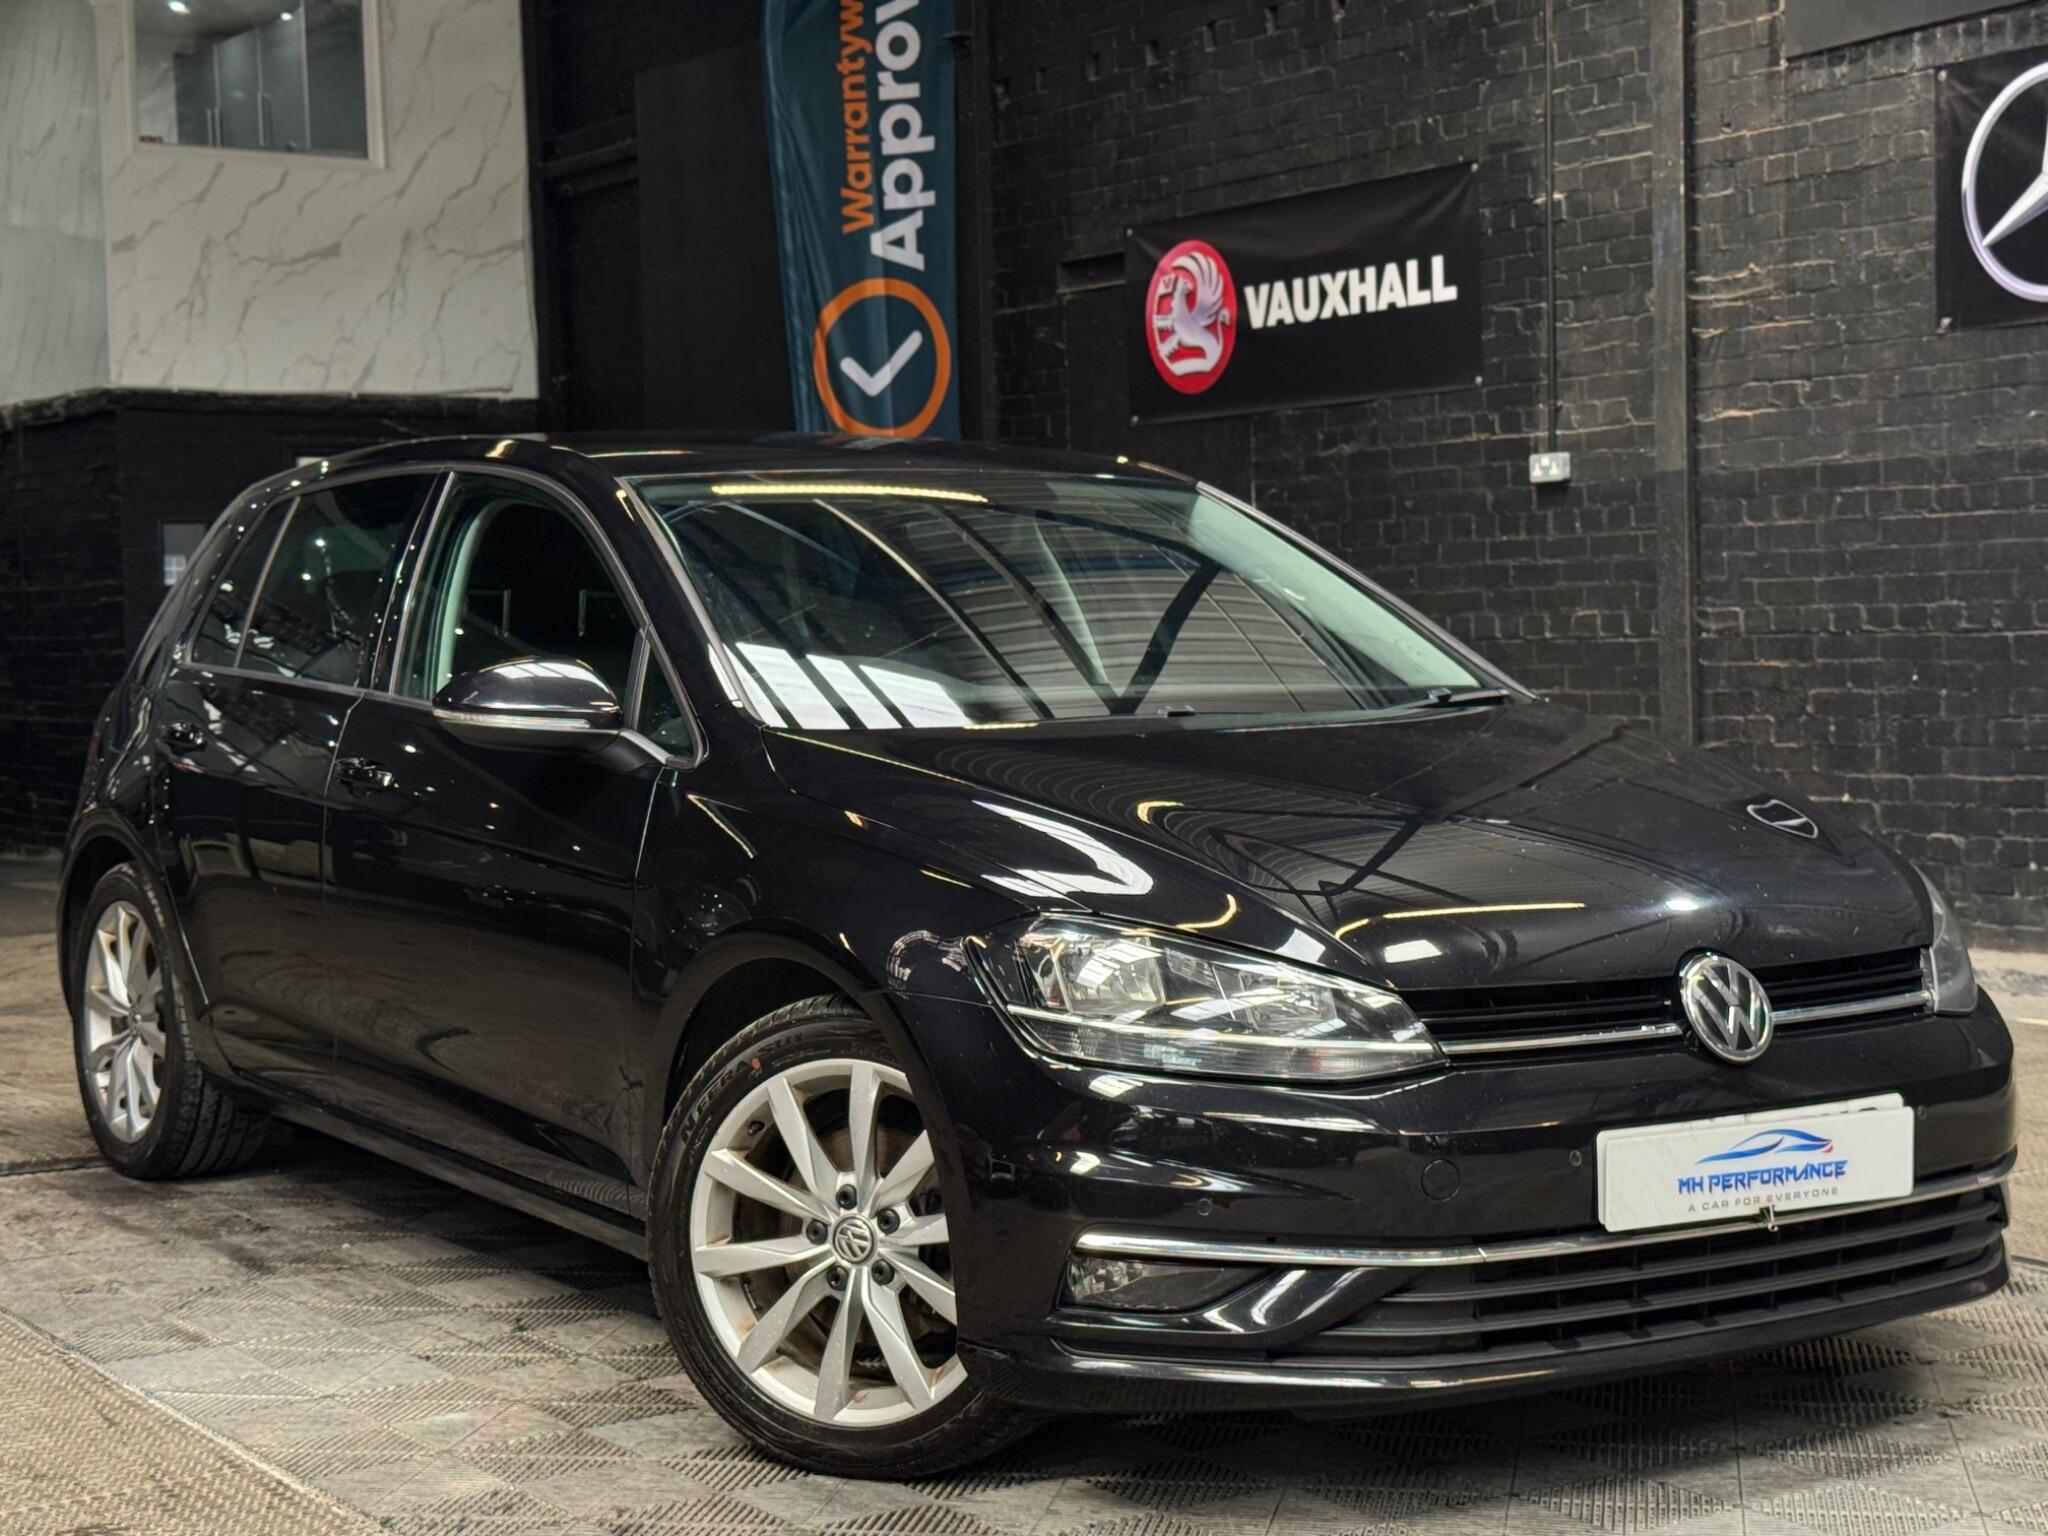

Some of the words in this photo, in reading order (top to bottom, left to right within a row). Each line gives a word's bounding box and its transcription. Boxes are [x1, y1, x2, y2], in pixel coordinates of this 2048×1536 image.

[1244, 255, 1458, 329] VAUXHALL
[1677, 1176, 1704, 1194] MH
[1709, 1160, 1848, 1193] PERFORMANCE
[1688, 1204, 1697, 1212] A
[1702, 1200, 1729, 1211] CAR
[1735, 1196, 1761, 1206] FOR
[1767, 1187, 1839, 1202] EVERYONE
